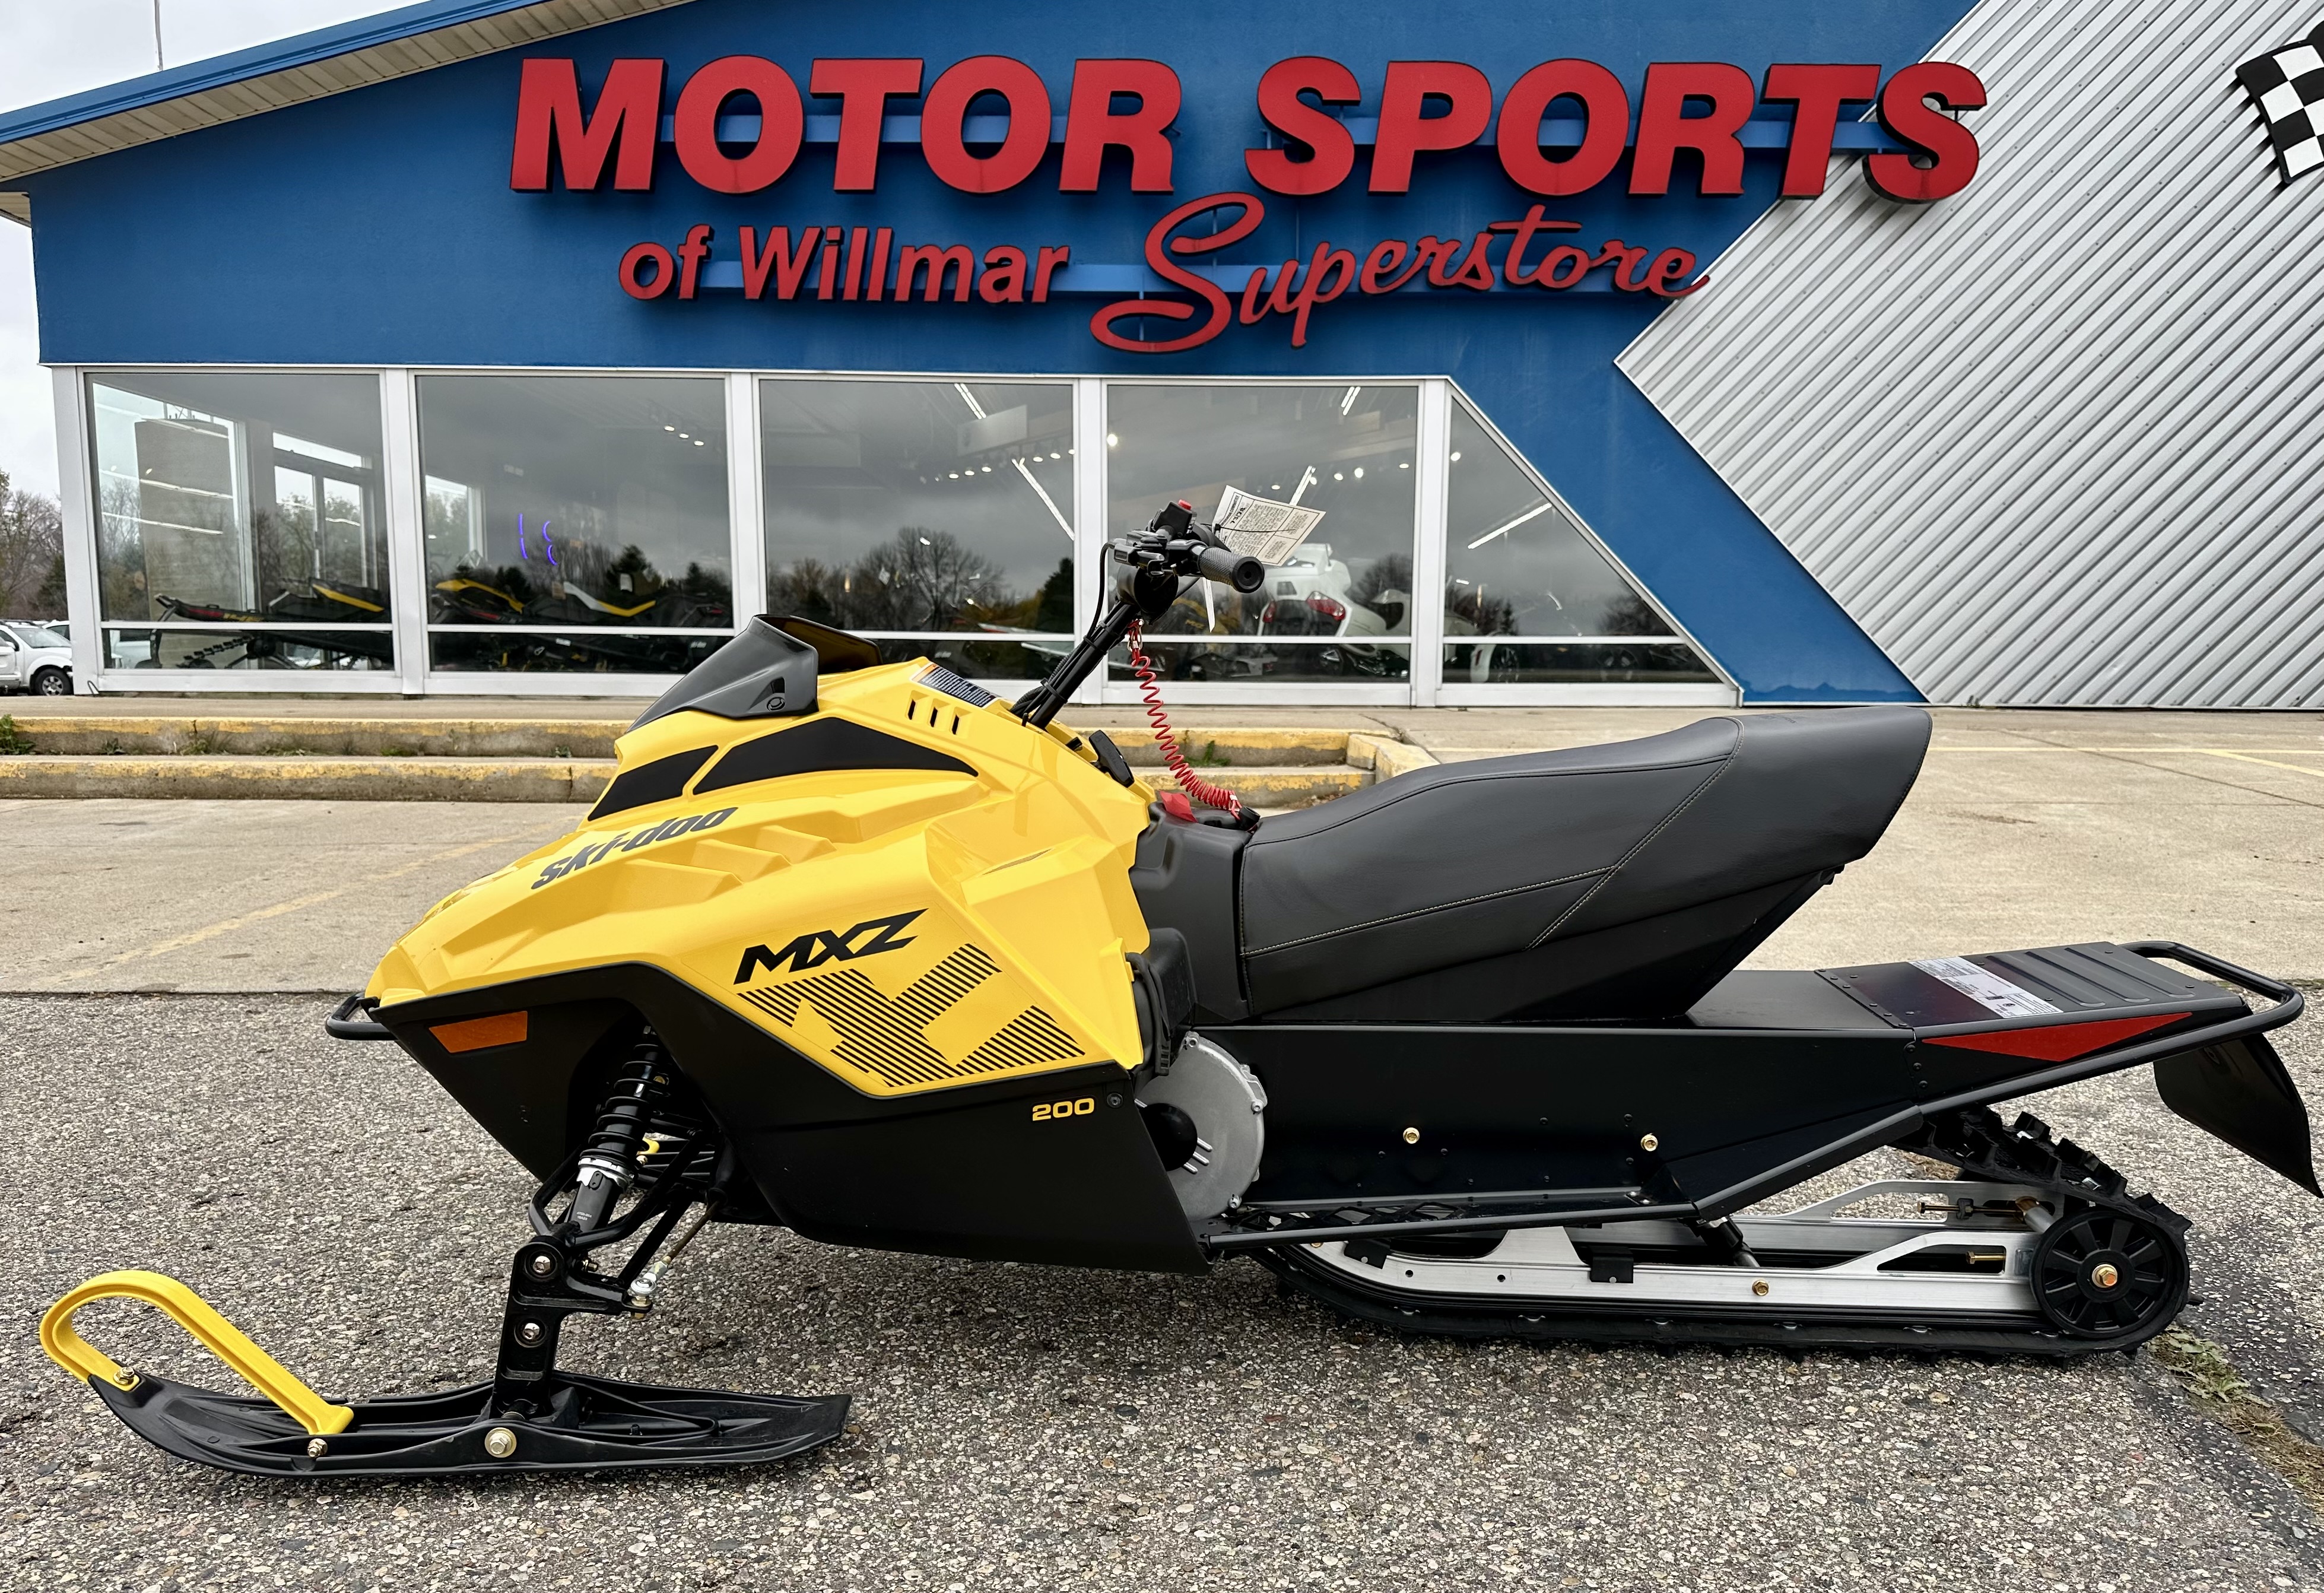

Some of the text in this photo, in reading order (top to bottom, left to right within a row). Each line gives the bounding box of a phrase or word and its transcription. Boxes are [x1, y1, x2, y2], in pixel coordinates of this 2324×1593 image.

[510, 55, 1988, 202] MOTOR SPORTS
[619, 224, 1070, 303] of Willmar
[1090, 191, 1710, 352] Superstore
[733, 907, 929, 985] MXZ
[1033, 1098, 1094, 1121] 200
